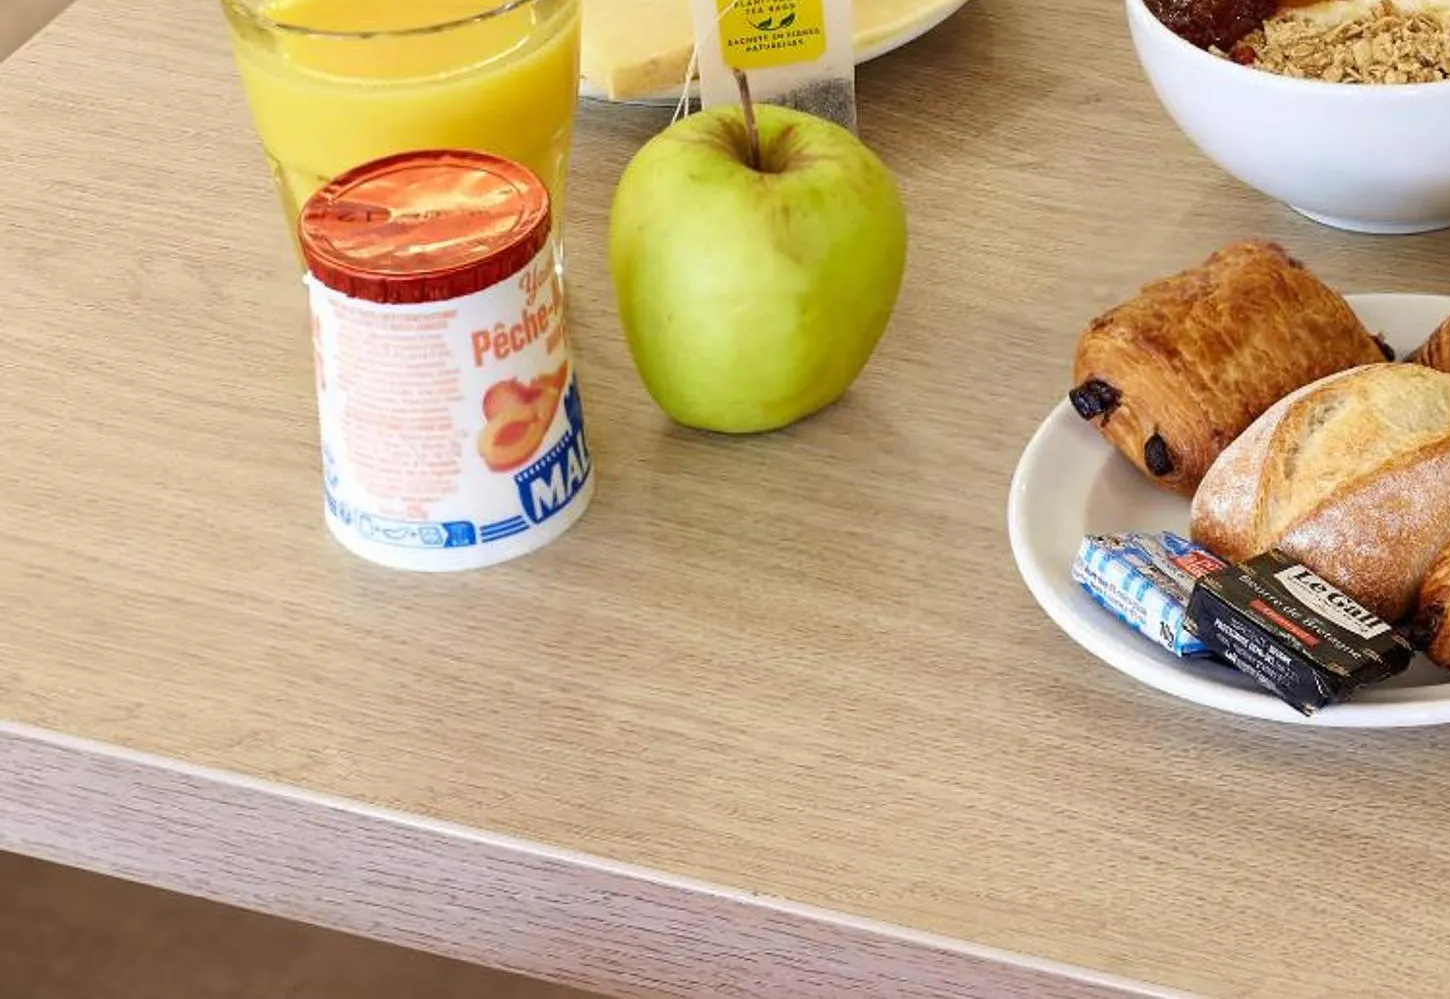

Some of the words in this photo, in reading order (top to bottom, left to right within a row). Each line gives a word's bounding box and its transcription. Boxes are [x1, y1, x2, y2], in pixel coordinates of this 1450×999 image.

[1283, 603, 1300, 619] de
[1291, 570, 1327, 593] Le
[1328, 592, 1382, 630] Gall
